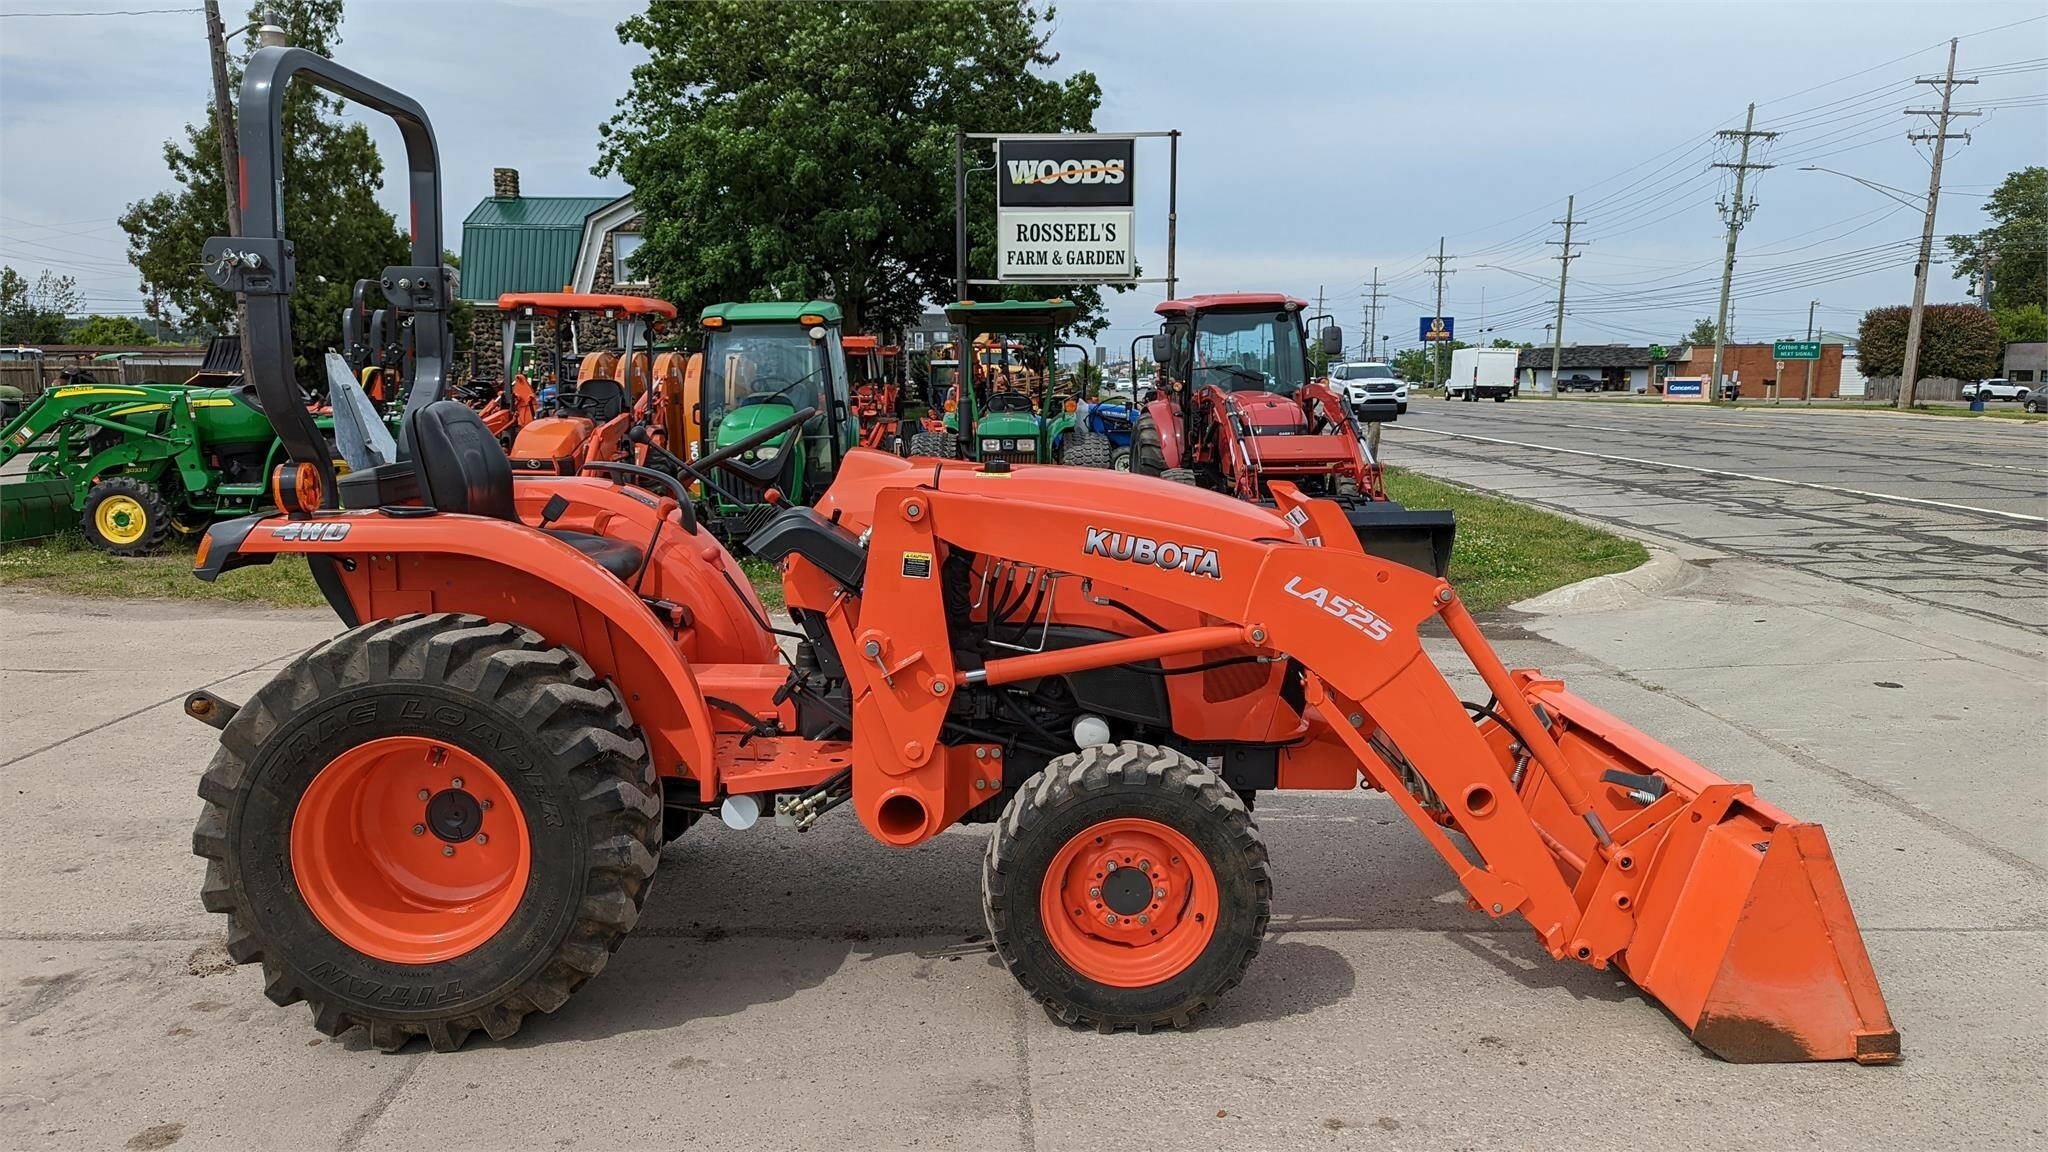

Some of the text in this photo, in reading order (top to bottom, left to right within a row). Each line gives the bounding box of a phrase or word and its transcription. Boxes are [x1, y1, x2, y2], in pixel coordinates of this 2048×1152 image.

[1007, 159, 1125, 185] WOODS
[1016, 223, 1116, 242] ROSSEEL'S
[1007, 250, 1125, 265] FARM & GARDEN
[272, 522, 352, 541] 4WD
[1084, 526, 1222, 580] KUBOTA
[1284, 575, 1393, 641] LA525
[307, 960, 464, 1006] TITAN
